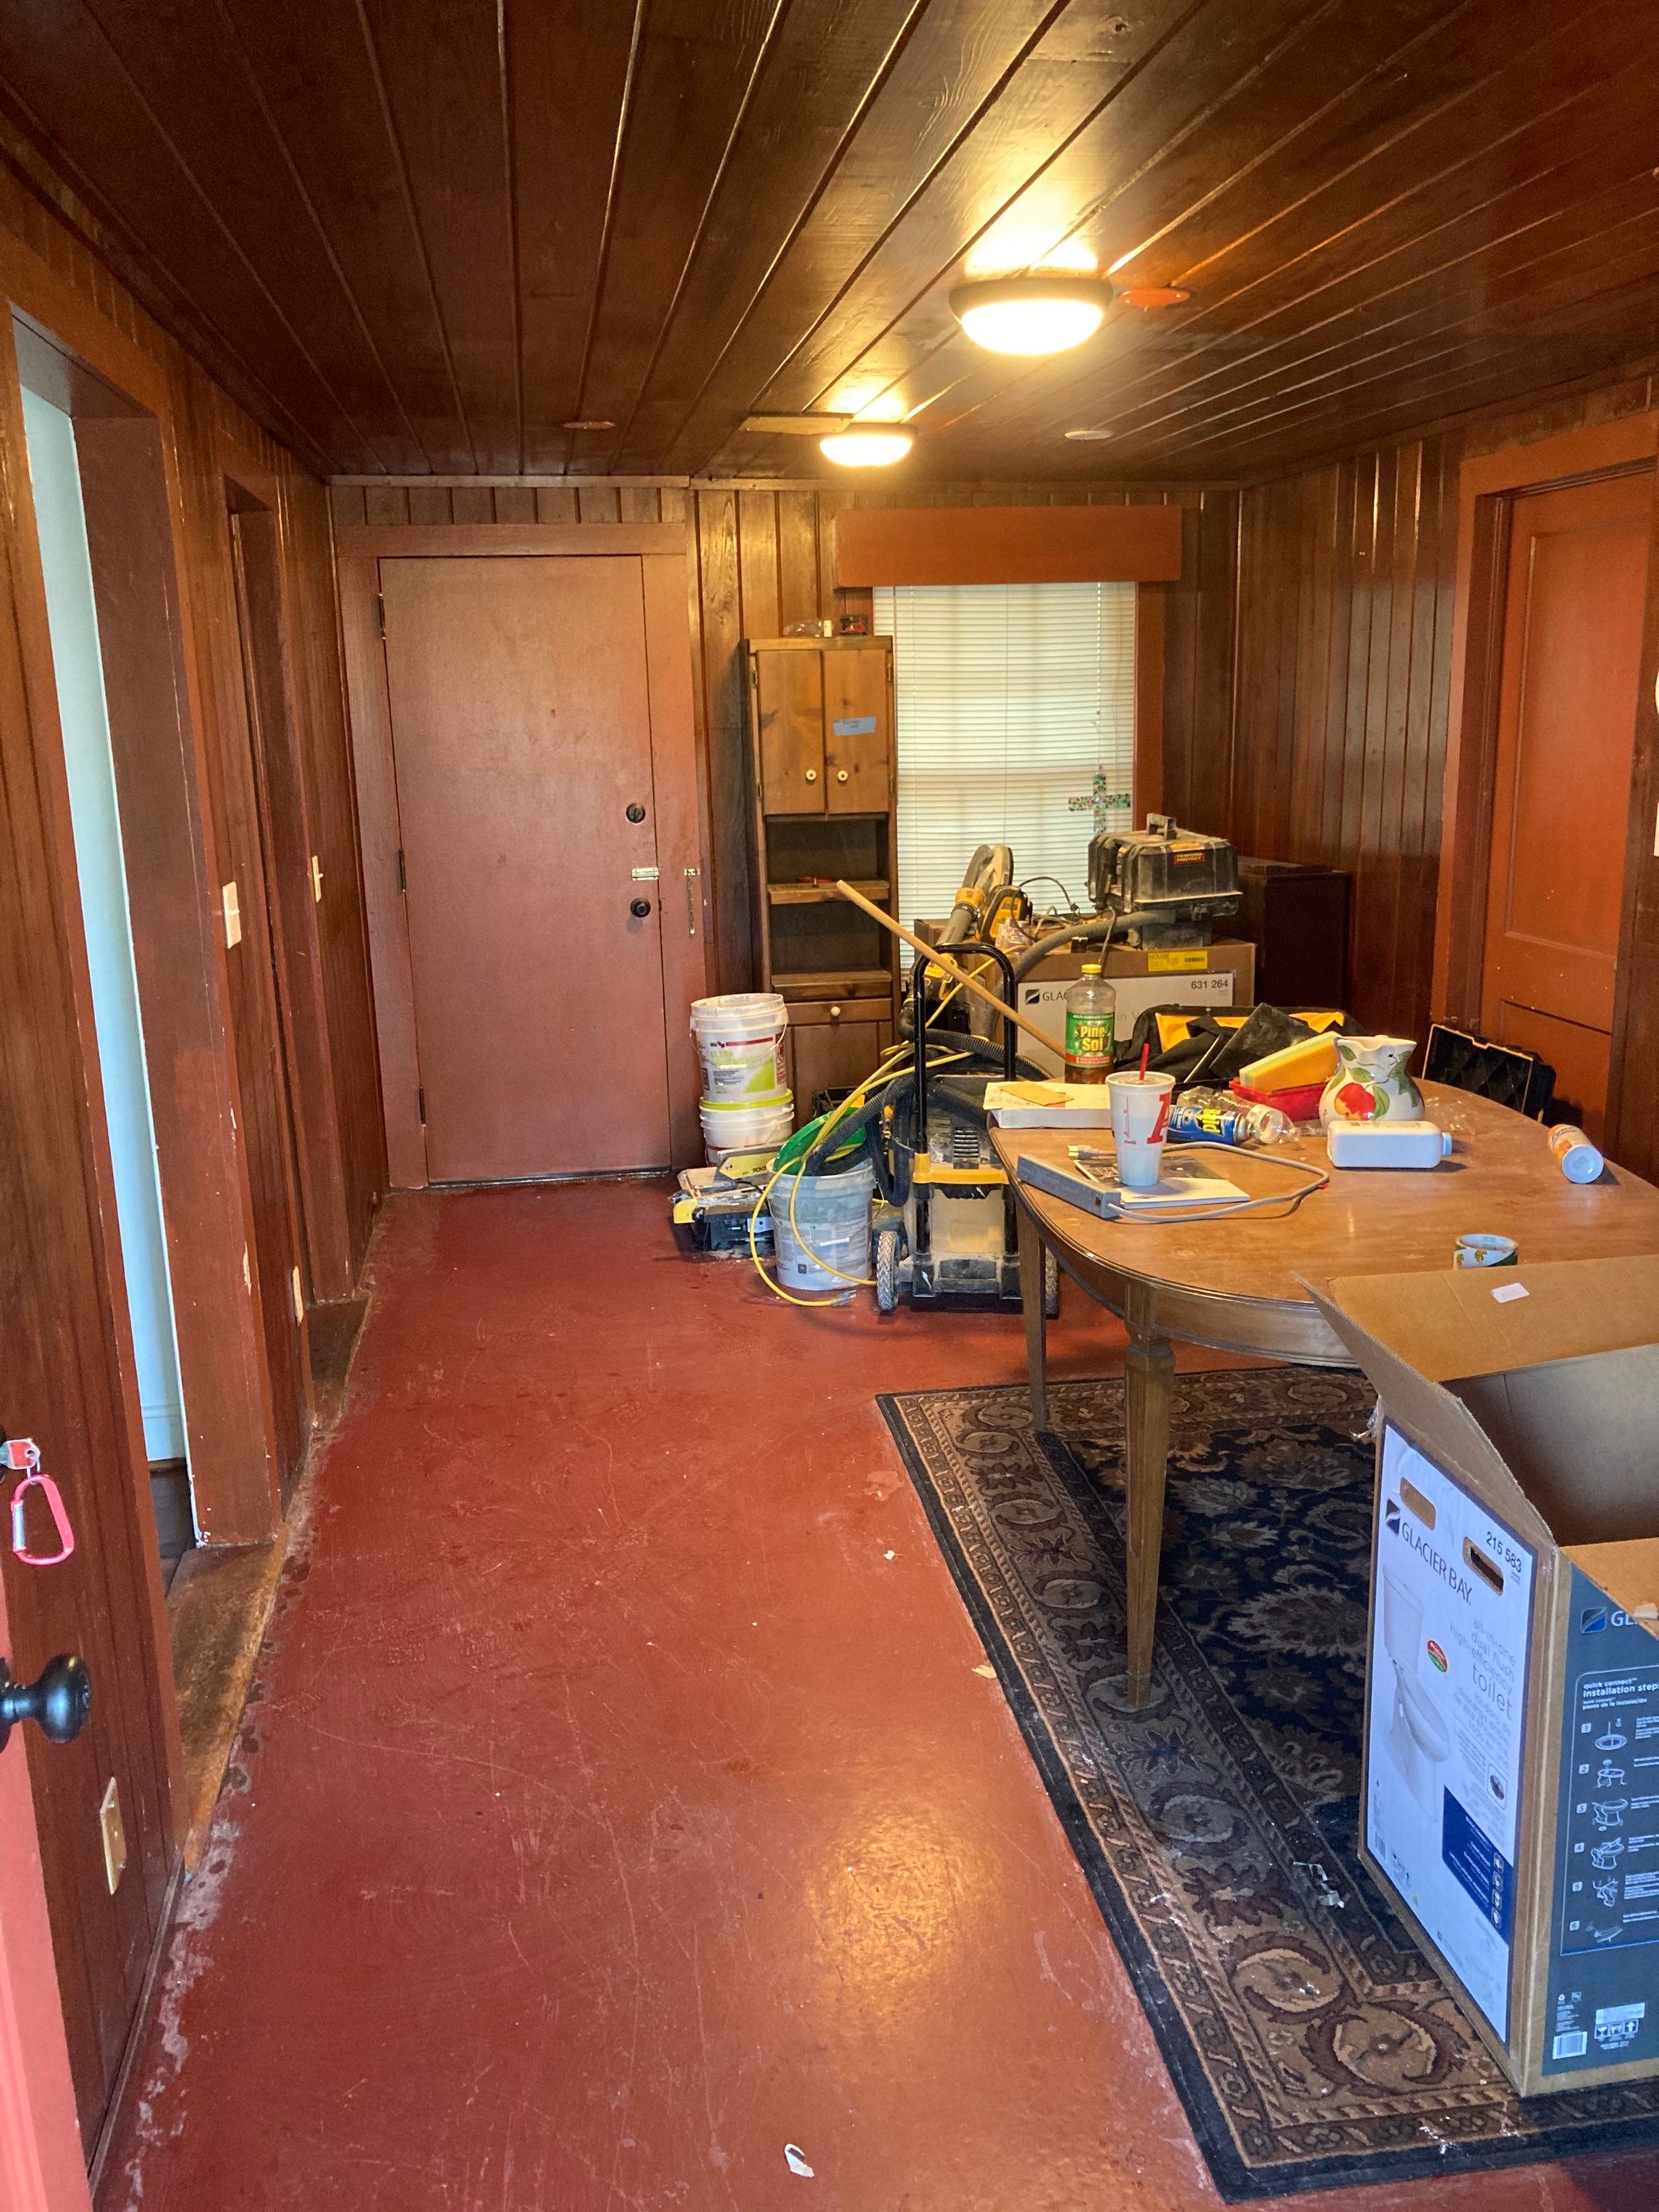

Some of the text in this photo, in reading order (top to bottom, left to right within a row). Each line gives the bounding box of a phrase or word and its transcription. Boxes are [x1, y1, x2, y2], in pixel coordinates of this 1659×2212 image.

[1191, 979, 1228, 989] 631 264
[1080, 1025, 1105, 1038] Pine
[1082, 1037, 1104, 1051] Sol
[1203, 1108, 1221, 1134] Raid
[1402, 1522, 1472, 1604] GLACIER BAY
[1486, 1532, 1522, 1573] 215 583
[1611, 1610, 1637, 1627] GL
[1449, 1620, 1513, 1696] high-efficiency
[1472, 1631, 1515, 1682] dual flush
[1473, 1618, 1516, 1667] all-in-one
[1472, 1661, 1512, 1720] toilet
[1637, 1684, 1659, 1692] step
